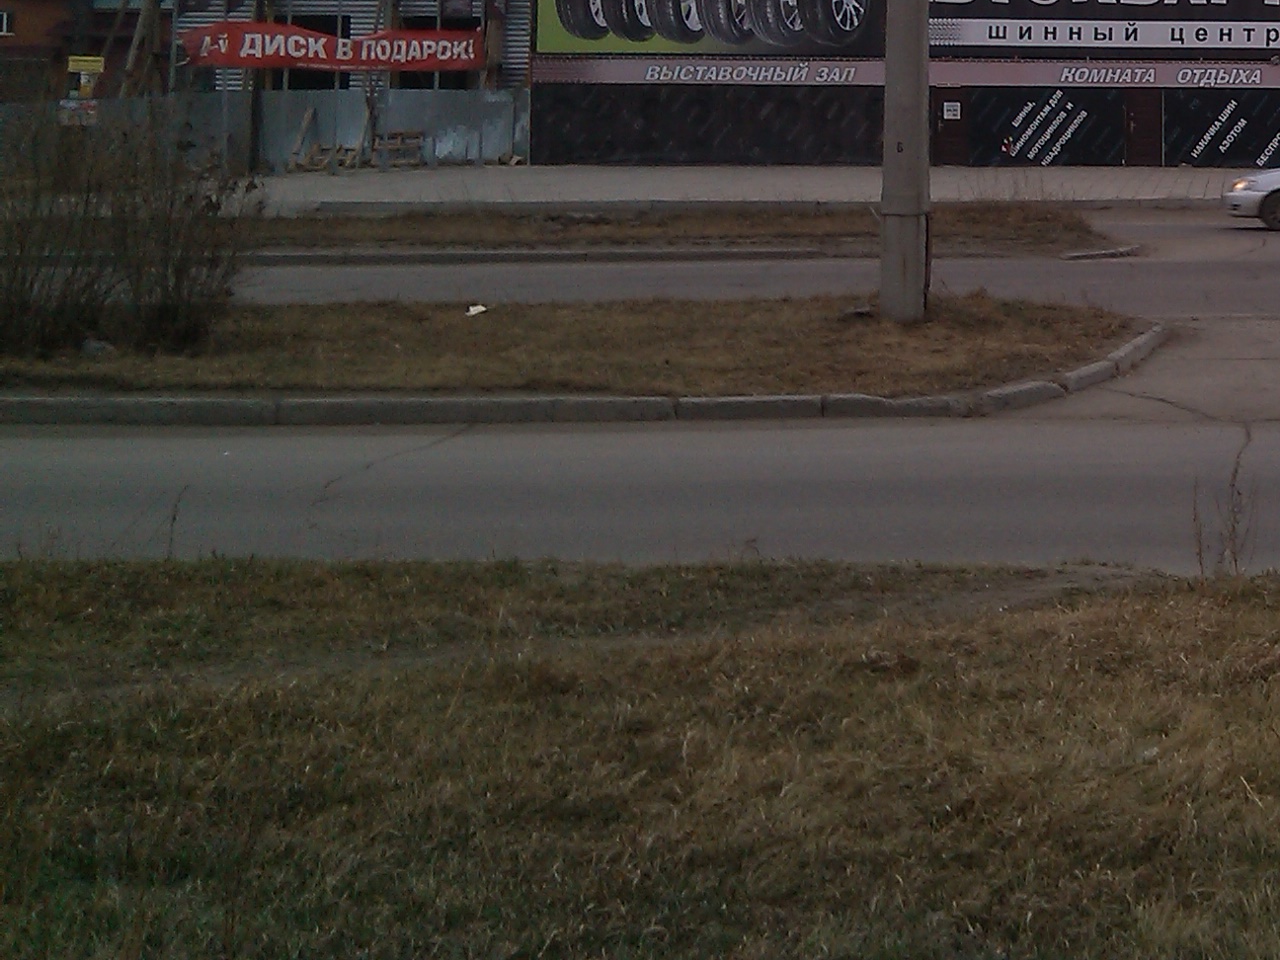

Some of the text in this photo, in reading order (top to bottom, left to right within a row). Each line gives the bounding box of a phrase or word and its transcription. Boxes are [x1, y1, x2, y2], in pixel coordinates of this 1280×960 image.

[239, 32, 328, 59] ДИСК
[336, 38, 353, 61] В
[361, 38, 476, 63] ПОДАРОК!
[988, 22, 1280, 47] шинный центр
[645, 62, 857, 82] ВЫСТАВОЧНЫЙ ЗАЛ
[1059, 67, 1262, 88] КОМНАТА ОТДЫХА
[1190, 99, 1238, 158] НАКАЧКА ШИН
[1218, 118, 1248, 153] АЗОТОМ
